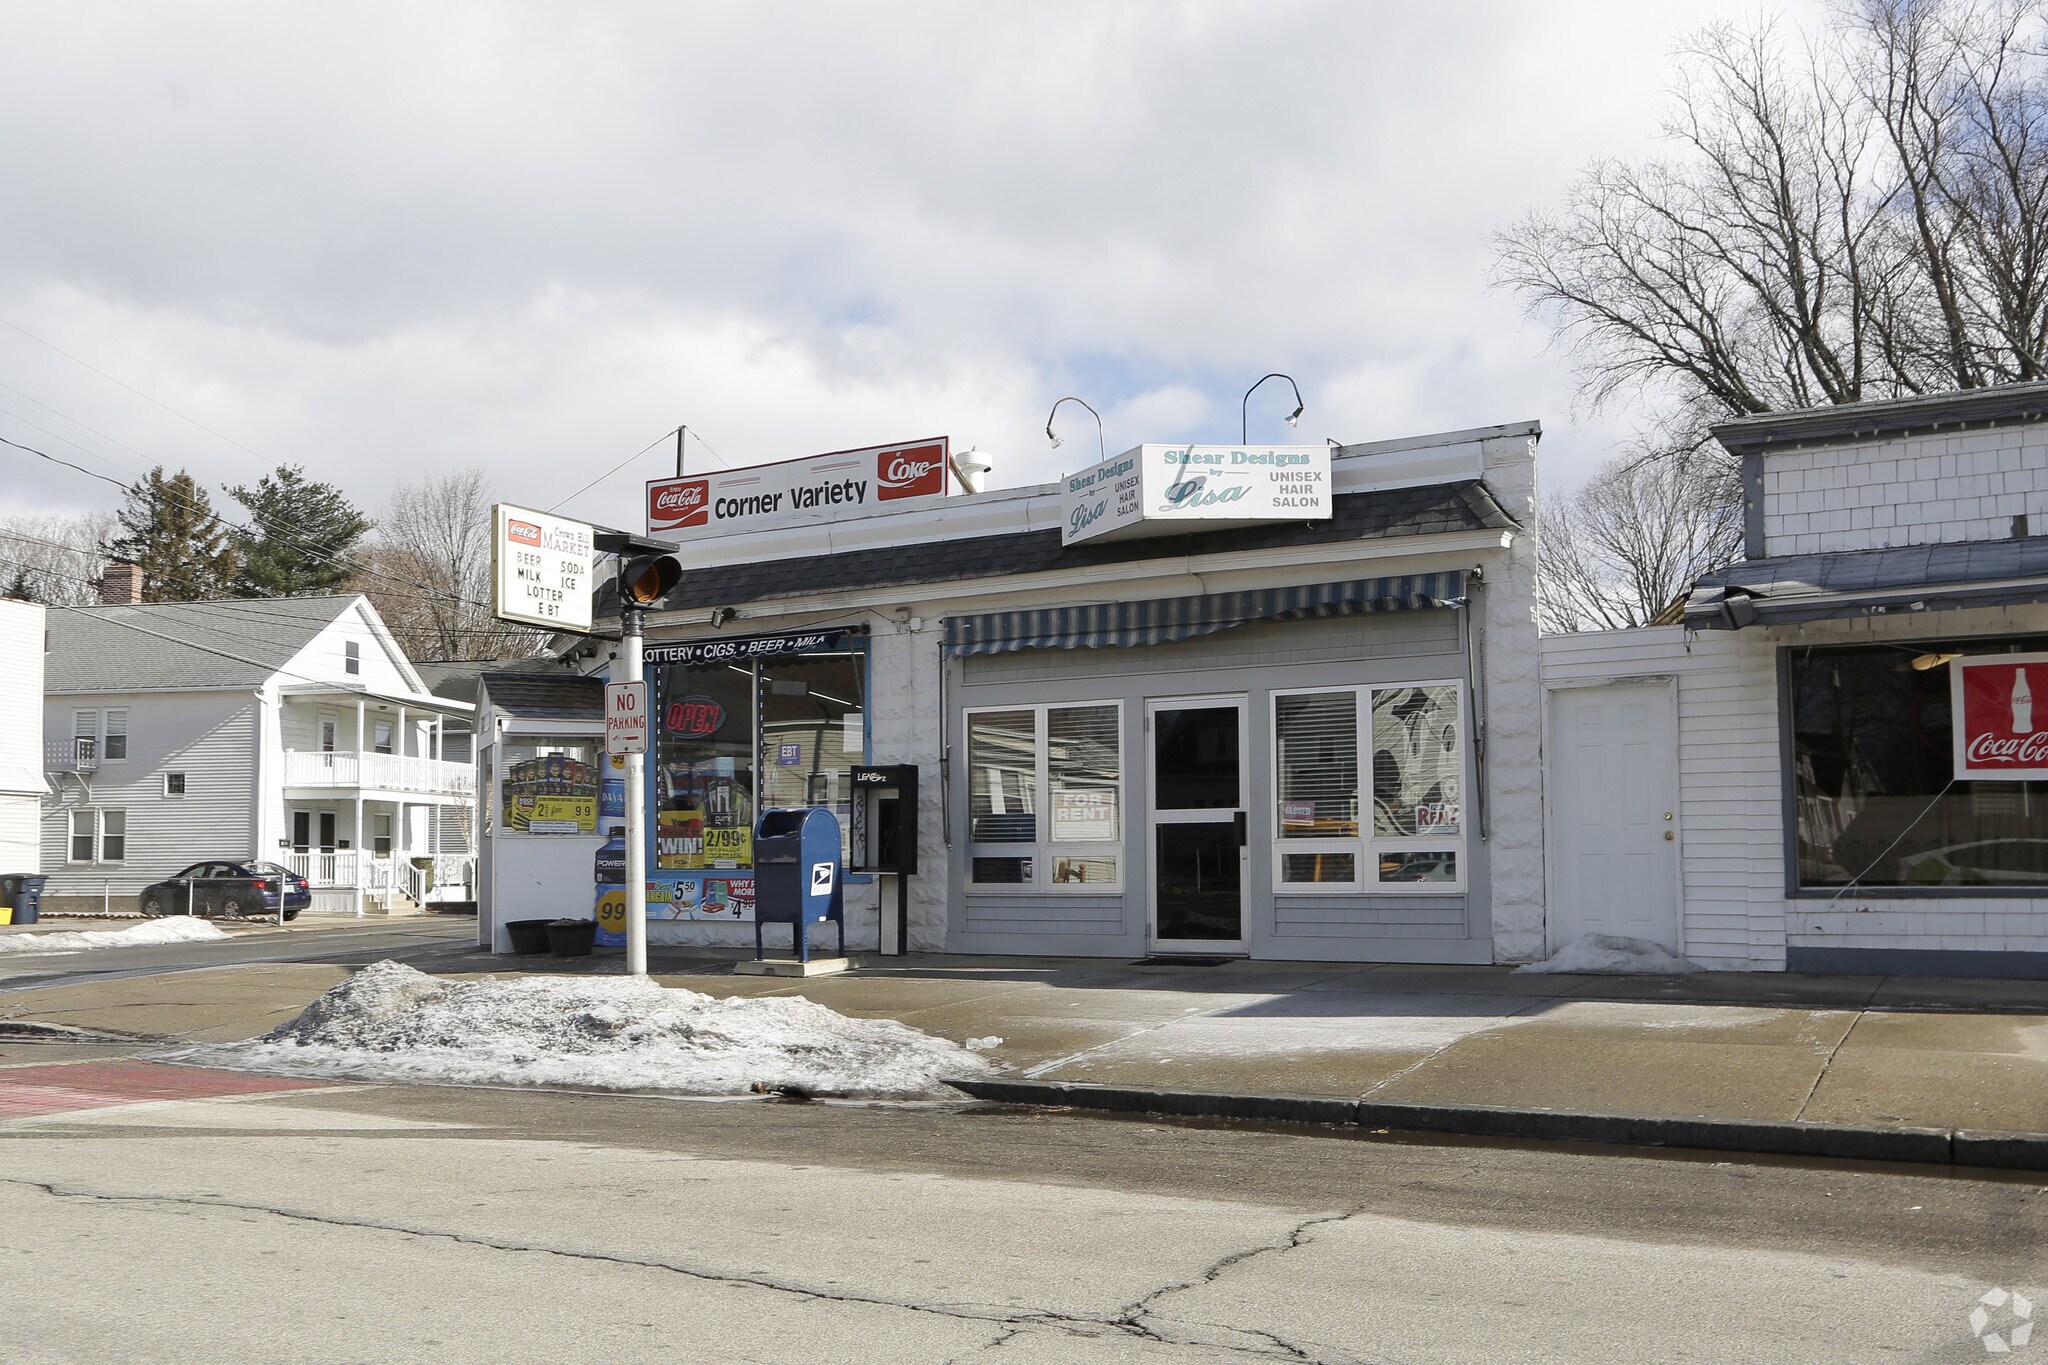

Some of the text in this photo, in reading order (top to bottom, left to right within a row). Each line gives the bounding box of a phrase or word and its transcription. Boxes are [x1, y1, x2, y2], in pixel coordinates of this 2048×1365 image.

[1163, 451, 1310, 467] Shear Designs
[888, 458, 930, 480] Coke
[1069, 459, 1134, 493] Shear Designs
[1209, 468, 1223, 476] by
[1114, 475, 1140, 493] UNISEX
[1269, 472, 1322, 482] UNISEX
[1119, 490, 1136, 503] HAIR
[1158, 480, 1252, 512] Lisa
[1279, 485, 1314, 495] HAIR
[657, 487, 703, 510] Coca-Cola
[715, 479, 867, 519] Corner Variety
[1272, 497, 1319, 507] SALON
[1117, 501, 1139, 517] SALON
[1068, 499, 1108, 538] Lisa
[511, 523, 538, 540] Coca-Cola
[555, 527, 574, 540] Crown
[543, 531, 590, 557] MARKET
[517, 552, 541, 566] BEER
[518, 567, 541, 582] MILK
[560, 561, 584, 576] SODA
[561, 577, 576, 590] ICE
[527, 585, 563, 602] LOTTER
[643, 647, 694, 662] OTTERY
[704, 643, 737, 658] CIGS.
[748, 640, 785, 652] BEER
[617, 693, 635, 711] NO
[609, 715, 645, 730] PARKING
[666, 703, 719, 733] OPEN
[781, 745, 797, 757] EBT
[1063, 794, 1102, 806] FOR
[538, 804, 544, 817] 2
[1057, 807, 1109, 820] RENT
[1286, 806, 1311, 815] CLOSED
[661, 837, 704, 854] WIN!
[730, 880, 749, 888] WHY
[646, 891, 672, 902] ARGAIN
[601, 903, 626, 920] 99
